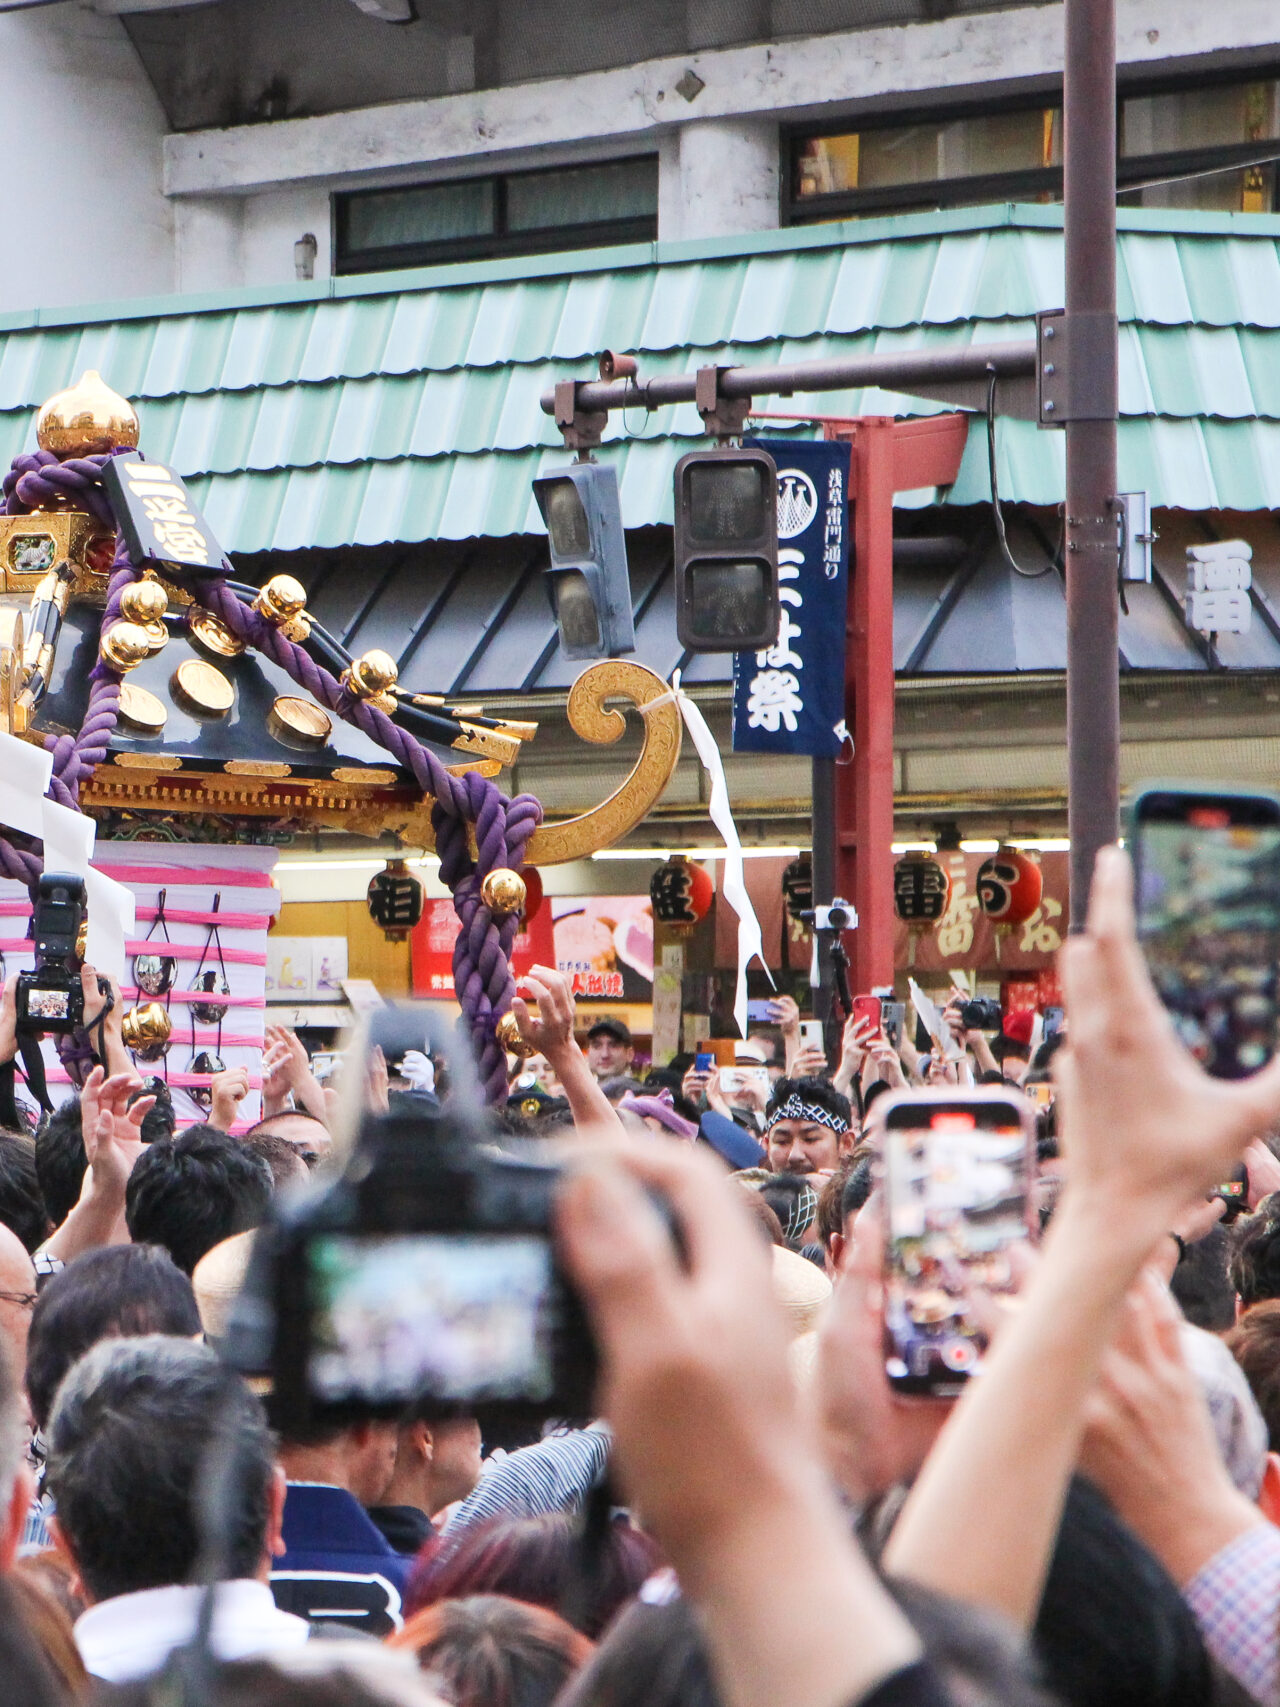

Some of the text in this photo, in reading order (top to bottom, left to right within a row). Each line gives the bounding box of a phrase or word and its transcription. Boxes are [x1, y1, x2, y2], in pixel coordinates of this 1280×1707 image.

[824, 468, 843, 580] 浅草雷門通り
